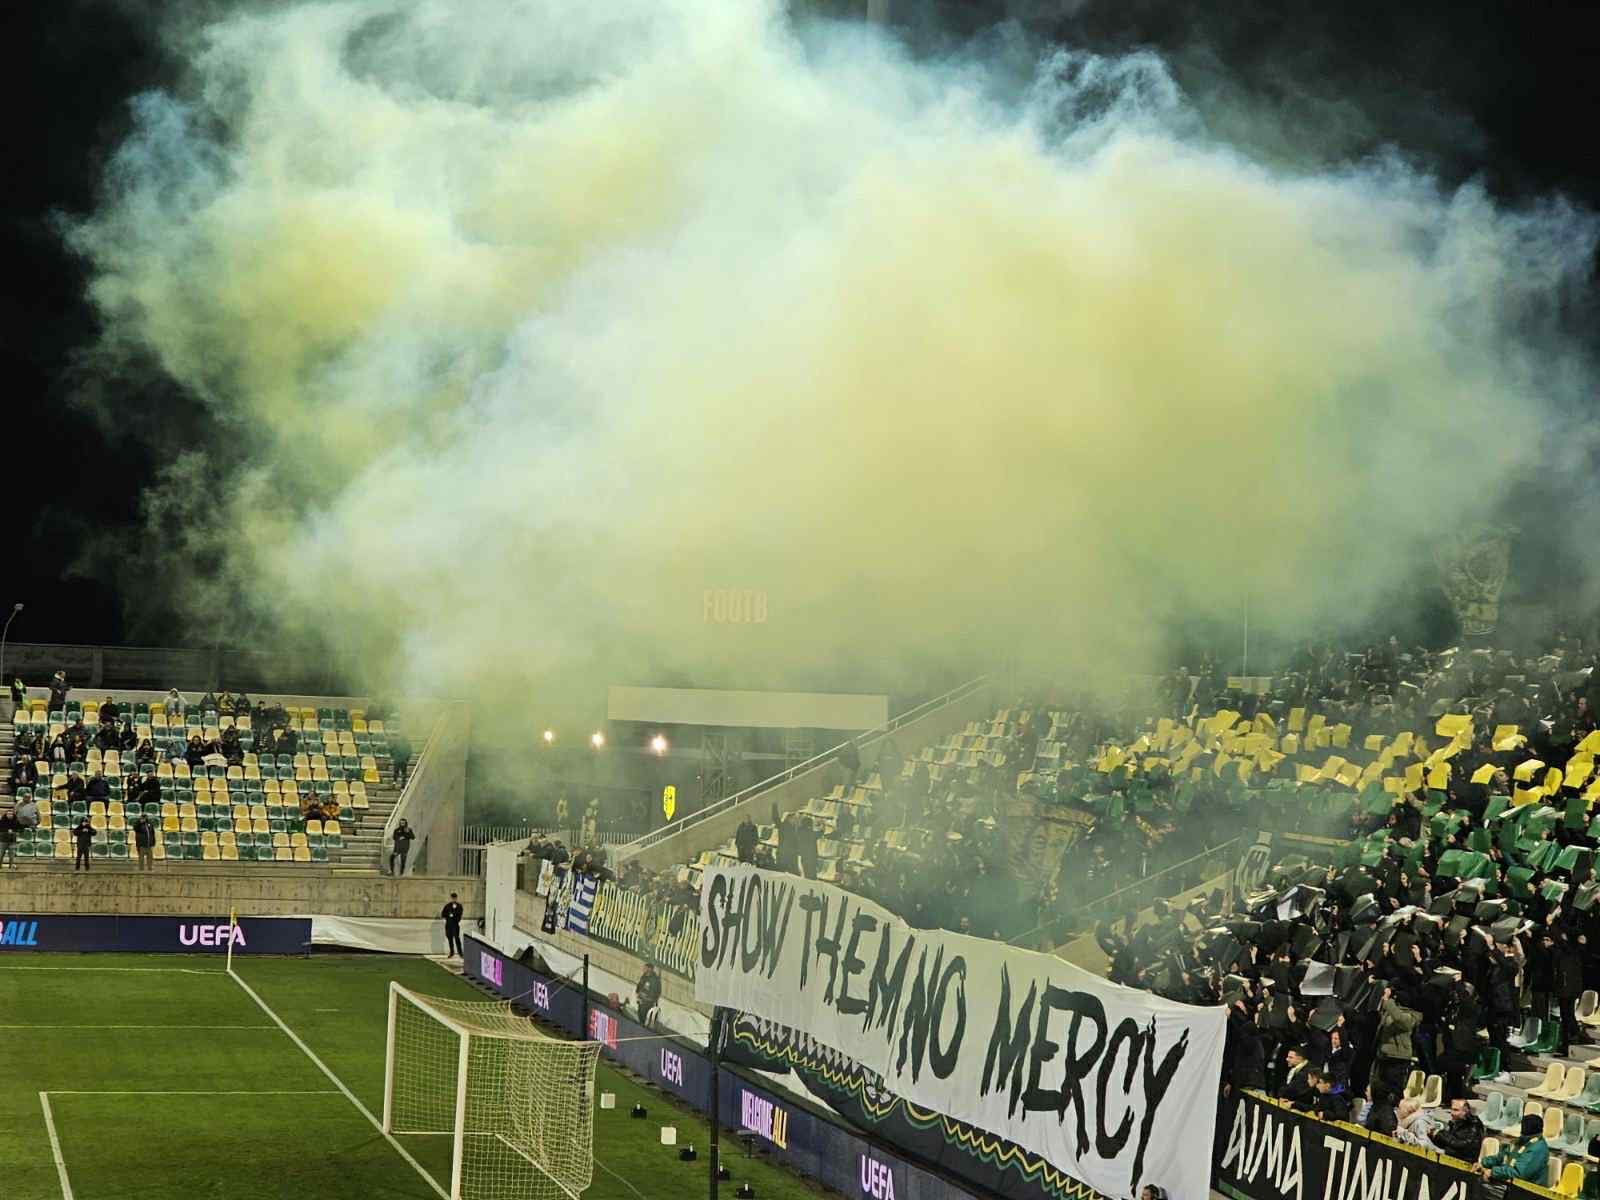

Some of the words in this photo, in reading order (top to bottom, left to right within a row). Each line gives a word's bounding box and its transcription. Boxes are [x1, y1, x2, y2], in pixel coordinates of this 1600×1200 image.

[179, 924, 247, 946] UEFA
[701, 873, 797, 980] SHOW
[799, 888, 916, 1040] THEM
[896, 942, 968, 1085] NO
[980, 960, 1191, 1198] MERCY
[660, 1048, 683, 1088] UEFA
[861, 1154, 896, 1200] UEFA
